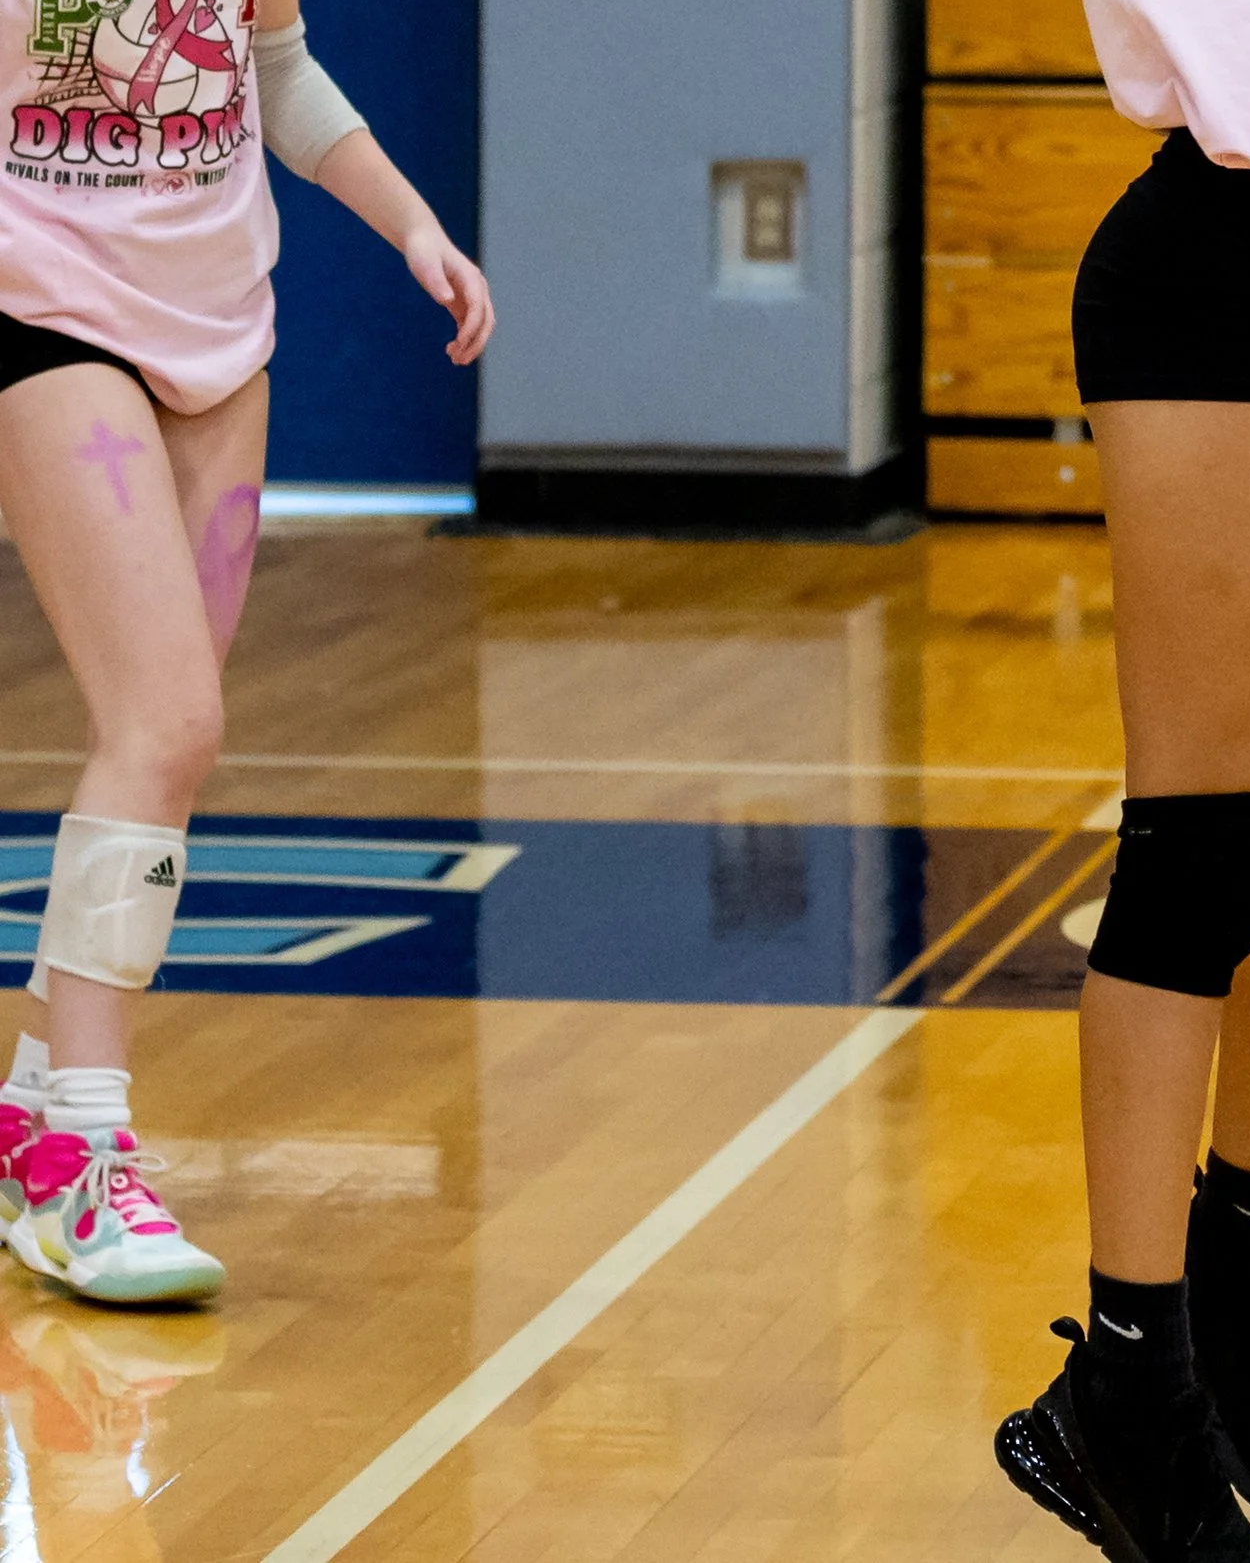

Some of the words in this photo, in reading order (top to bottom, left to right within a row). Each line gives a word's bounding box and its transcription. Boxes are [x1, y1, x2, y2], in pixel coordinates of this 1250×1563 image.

[10, 104, 142, 167] DIG
[5, 161, 49, 183] RIVALS
[54, 170, 71, 186] ON
[76, 172, 100, 187] THE
